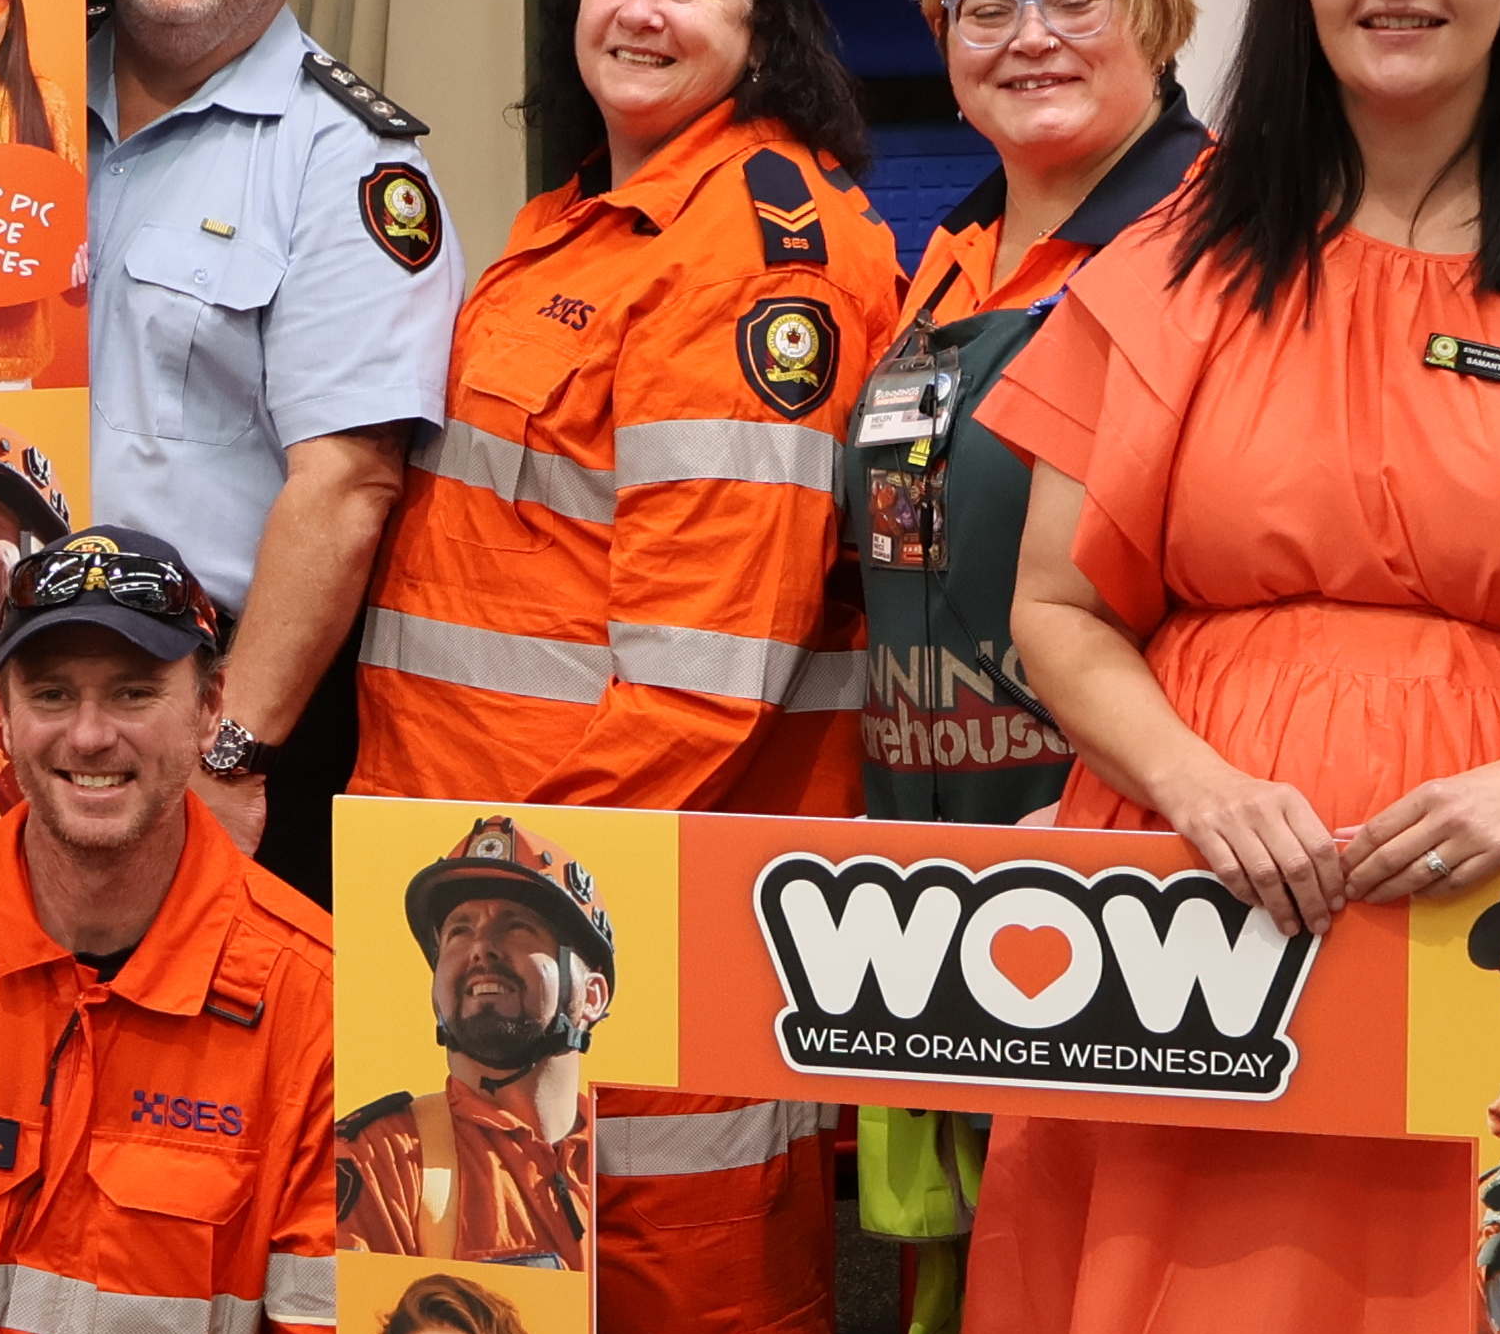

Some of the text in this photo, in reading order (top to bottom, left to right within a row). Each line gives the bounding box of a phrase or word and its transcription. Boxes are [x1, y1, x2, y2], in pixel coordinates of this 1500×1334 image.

[10, 193, 55, 227] PIC
[782, 237, 809, 250] SES
[780, 879, 1292, 1038] WOW
[796, 1026, 1274, 1079] WEAR ORANGE WEDNESDAY
[168, 1098, 242, 1135] SES
